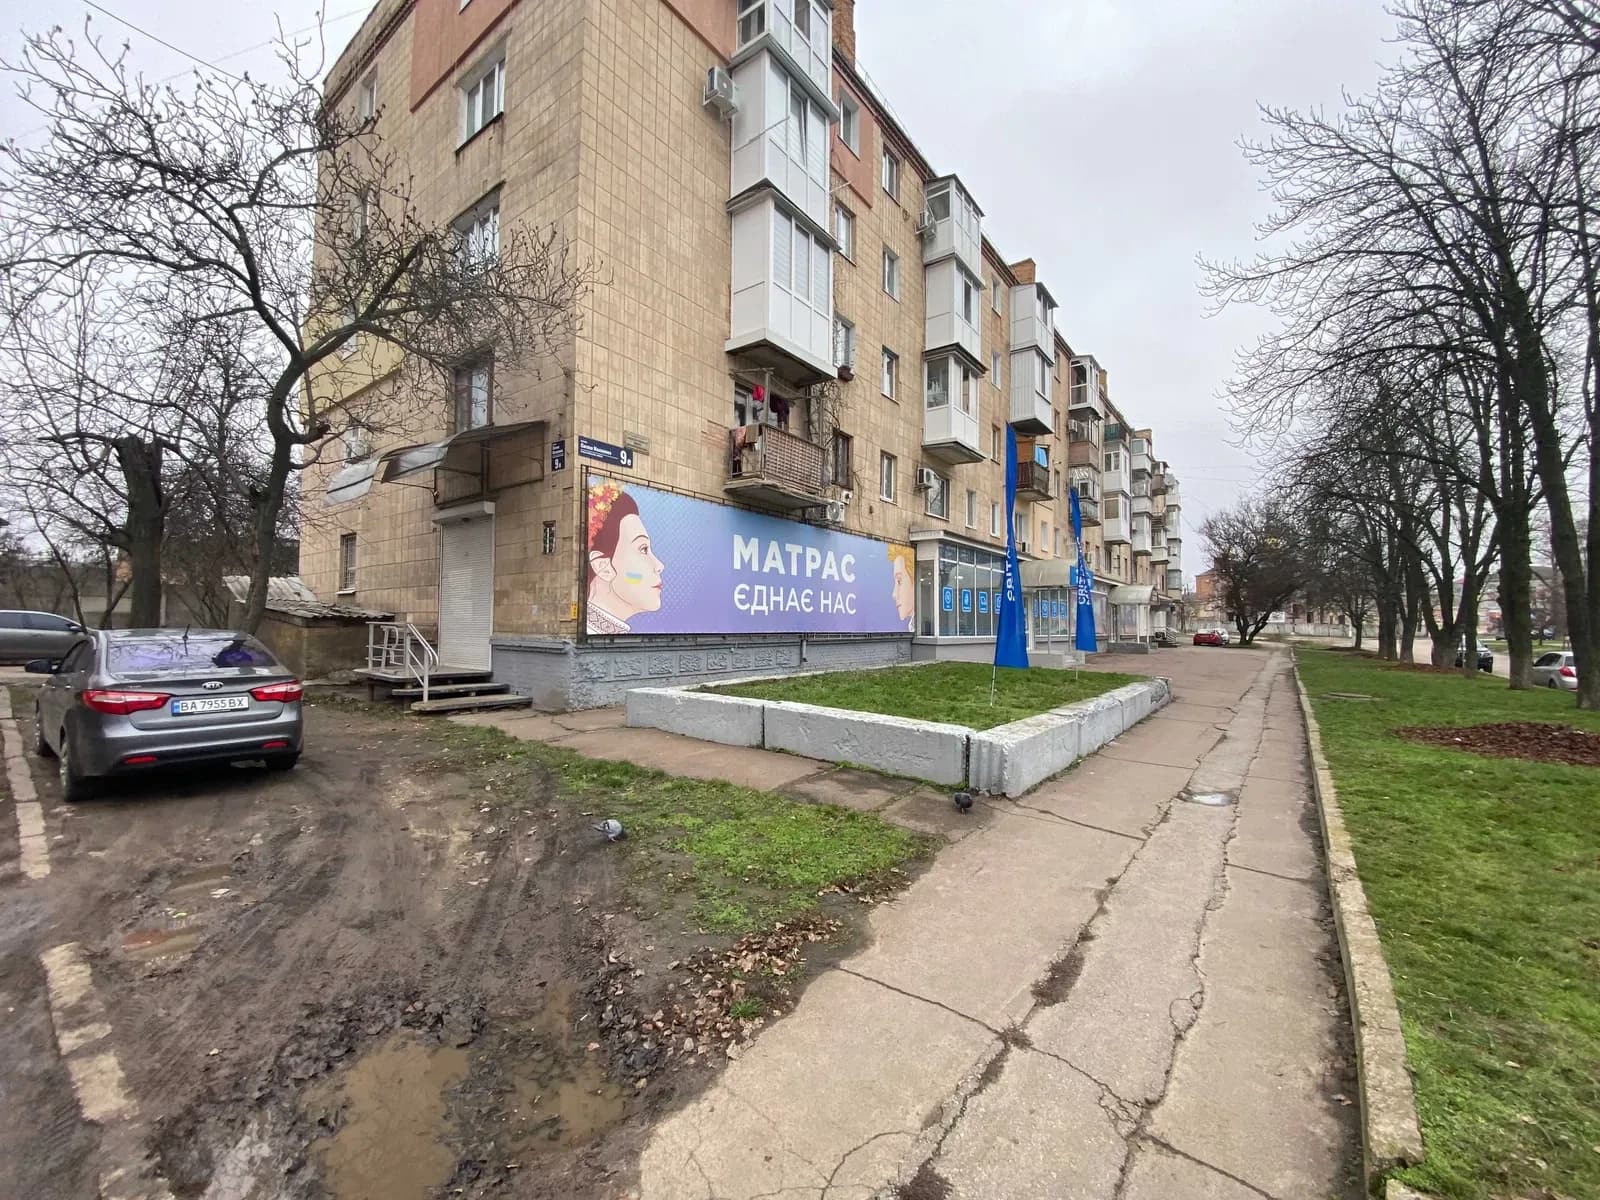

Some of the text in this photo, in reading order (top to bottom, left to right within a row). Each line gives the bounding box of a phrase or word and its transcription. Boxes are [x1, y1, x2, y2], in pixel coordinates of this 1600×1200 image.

[733, 534, 856, 583] МАТРАС
[733, 583, 857, 616] ЄДНАЄ НАС
[181, 698, 244, 711] BA 7955 BX
